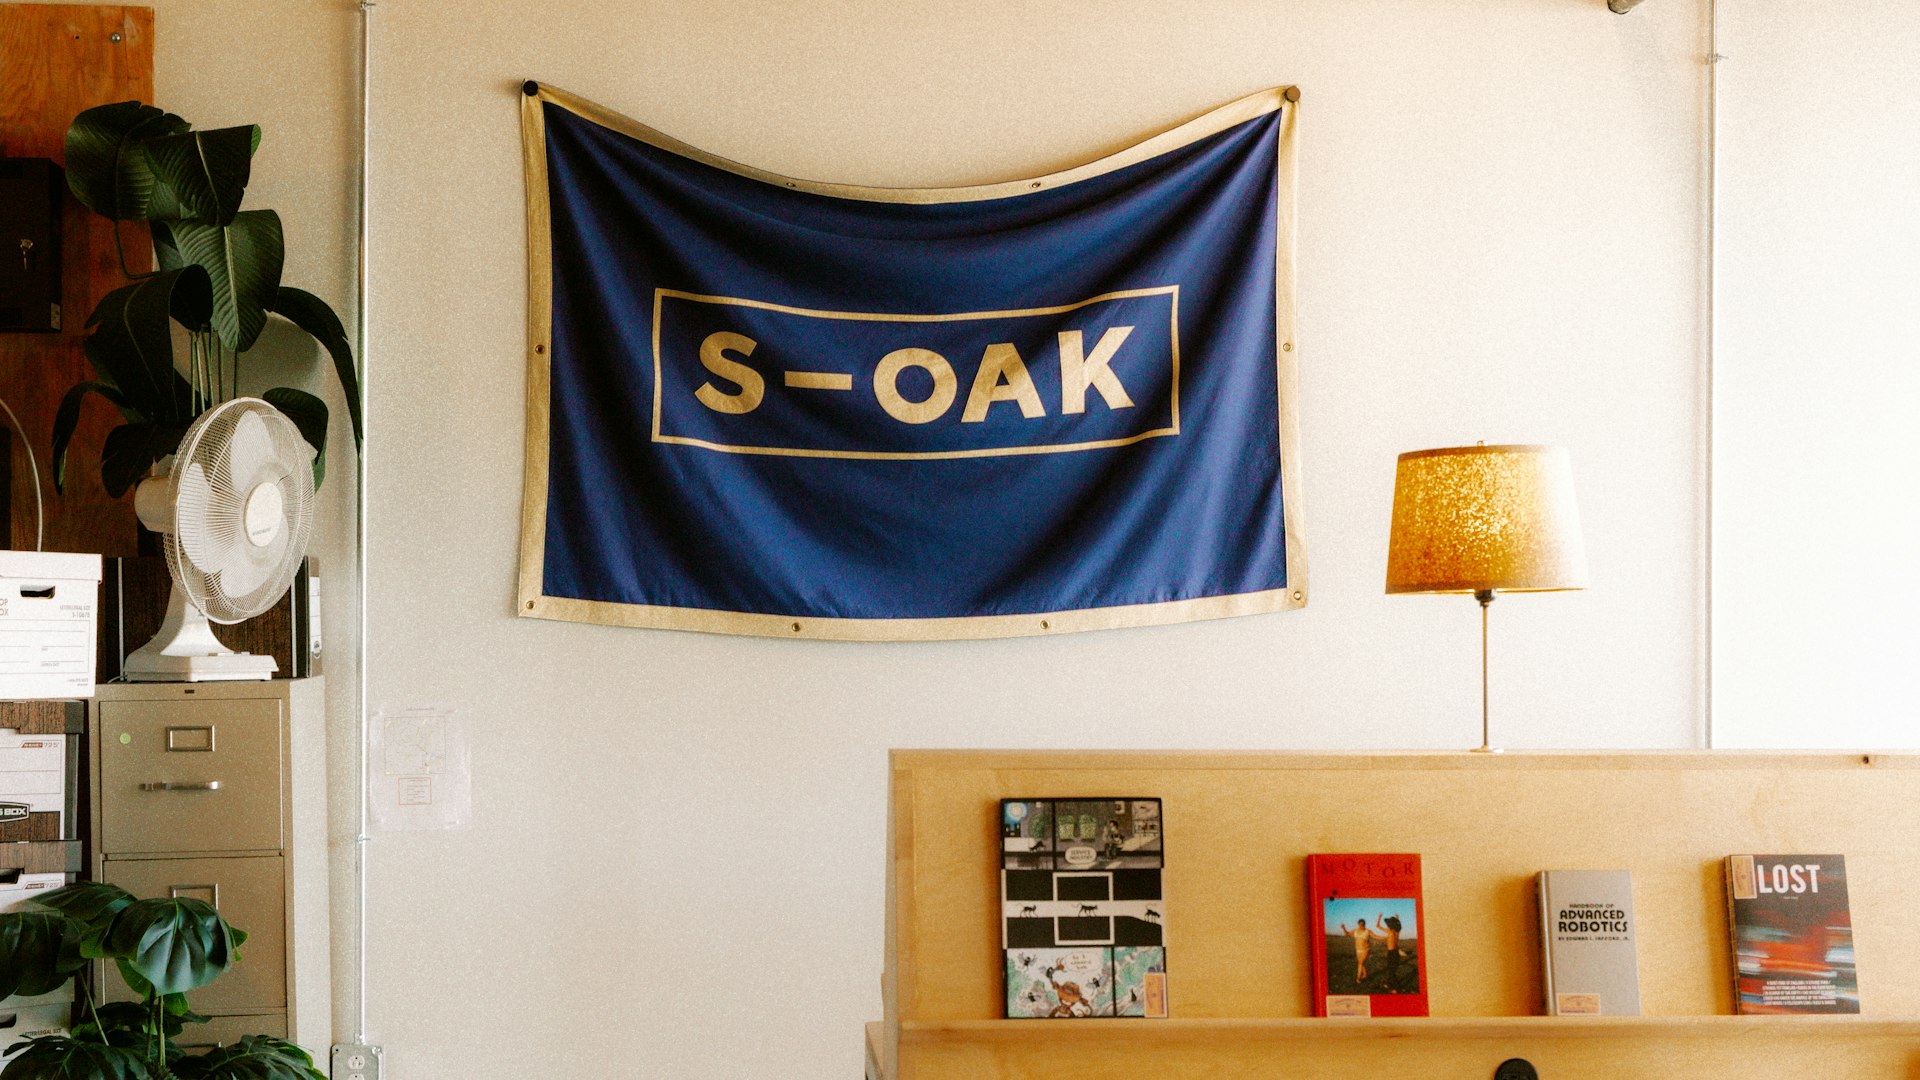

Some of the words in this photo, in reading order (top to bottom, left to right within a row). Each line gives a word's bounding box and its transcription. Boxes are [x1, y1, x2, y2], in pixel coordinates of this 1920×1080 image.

[4, 808, 26, 816] BOX
[1321, 858, 1415, 878] MOTOR
[1757, 864, 1820, 893] LOST
[1560, 910, 1624, 919] ADVANCED
[1558, 921, 1628, 932] ROBOTICS
